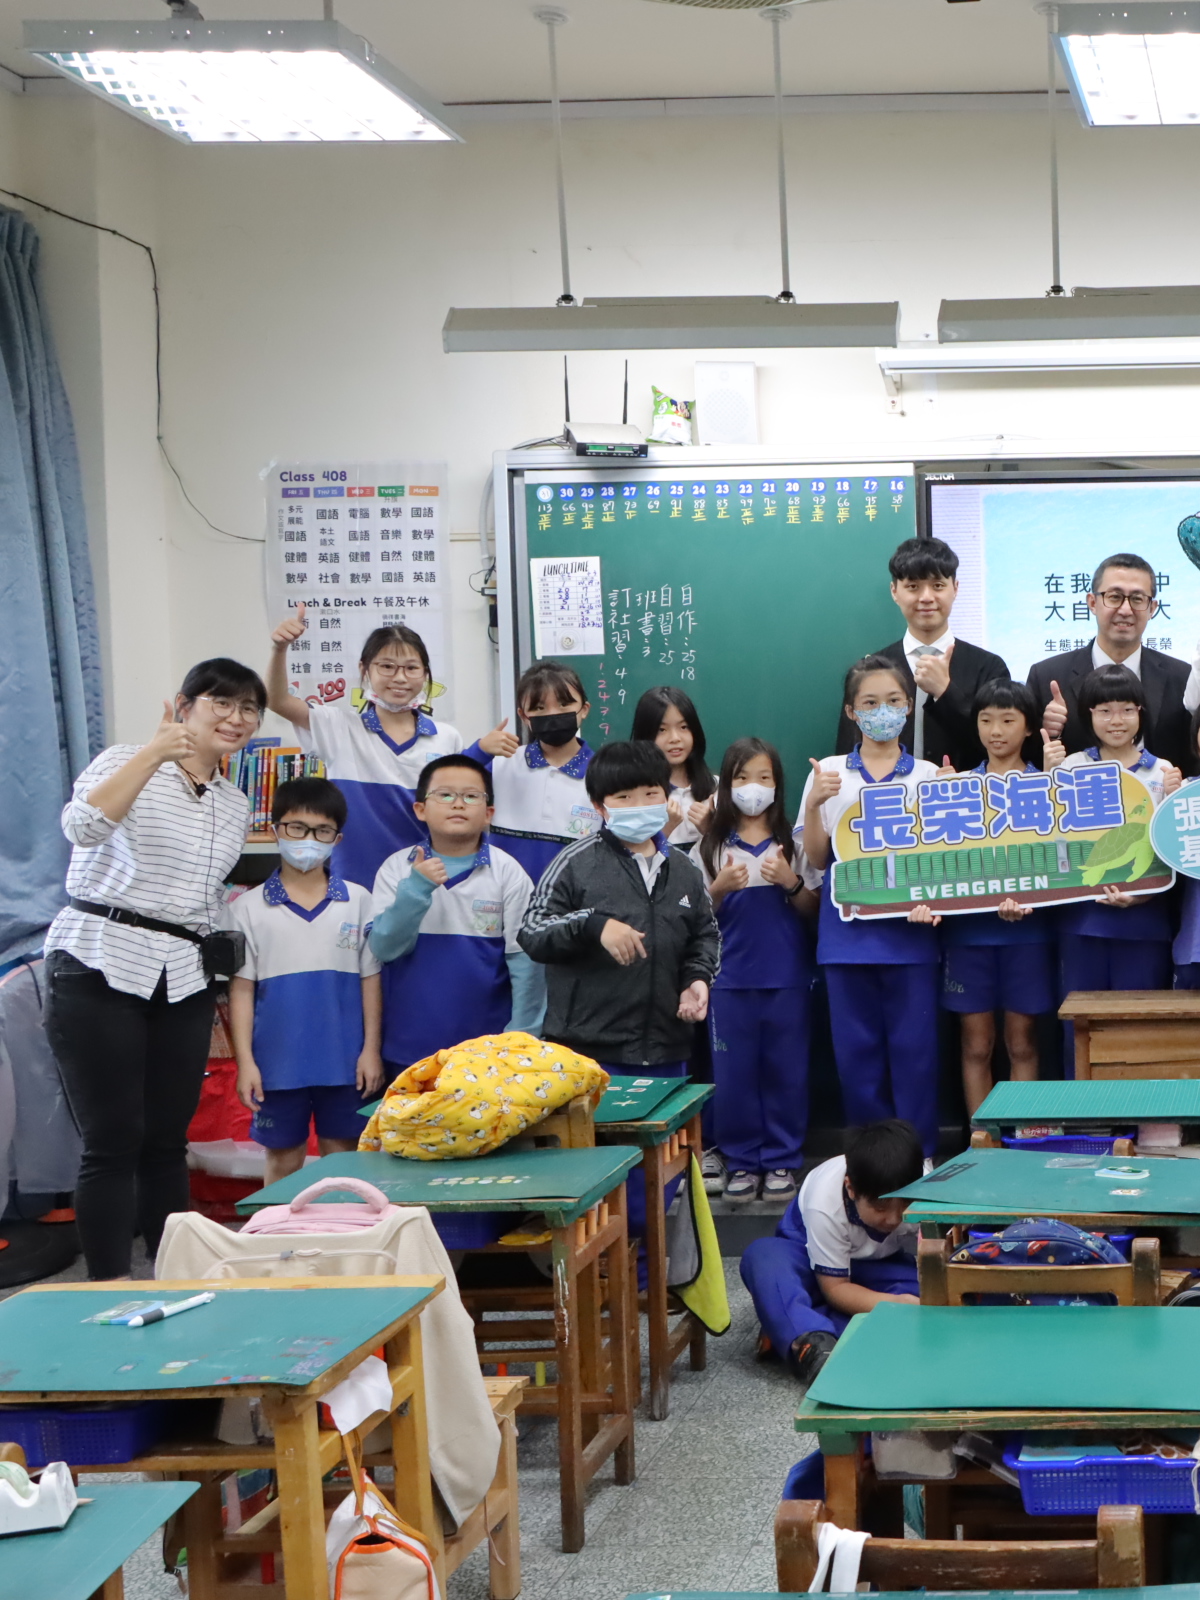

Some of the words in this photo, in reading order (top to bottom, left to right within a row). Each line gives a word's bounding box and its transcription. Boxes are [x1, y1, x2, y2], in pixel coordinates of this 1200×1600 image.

[280, 470, 316, 482] Class
[322, 470, 348, 482] 408
[560, 488, 574, 498] 30
[580, 488, 594, 498] 29
[600, 486, 615, 496] 28
[622, 486, 637, 496] 27
[646, 486, 660, 496] 26
[670, 486, 684, 495] 25
[692, 485, 706, 494] 24
[716, 484, 730, 494] 23
[738, 484, 753, 494] 22
[762, 482, 776, 492] 21
[786, 482, 800, 492] 20
[812, 482, 825, 491] 19
[836, 482, 850, 491] 18
[864, 480, 878, 490] 17
[890, 480, 904, 490] 16
[538, 504, 552, 514] 113
[562, 502, 576, 512] 66
[581, 502, 594, 512] 90
[602, 501, 615, 511] 87
[648, 500, 660, 510] 69
[670, 499, 682, 509] 91
[693, 500, 706, 508] 88
[716, 498, 728, 508] 85
[740, 498, 753, 508] 99
[764, 498, 776, 508] 70
[788, 496, 800, 506] 68
[812, 496, 826, 505] 93
[836, 498, 850, 508] 66
[865, 496, 878, 506] 95
[892, 494, 903, 504] 58
[288, 506, 304, 514] 多元
[316, 508, 338, 520] 國語
[348, 508, 370, 519] 電腦
[380, 508, 402, 518] 數學
[411, 507, 434, 518] 國語
[284, 530, 306, 542] 國語
[320, 527, 334, 535] 本土
[348, 530, 370, 541] 國語
[380, 529, 402, 540] 音樂
[412, 529, 434, 540] 數學
[320, 538, 334, 546] 語文
[284, 552, 308, 563] 健體
[318, 552, 340, 564] 英語
[348, 551, 370, 562] 健體
[381, 550, 402, 562] 自然
[412, 550, 435, 562] 健體
[543, 564, 568, 576] LUNCH
[571, 561, 588, 574] TIME
[286, 572, 308, 584] 數學
[318, 572, 340, 584] 社會
[350, 572, 372, 584] 數學
[382, 572, 404, 582] 國語
[412, 572, 436, 582] 英語
[323, 598, 331, 608] &
[334, 598, 367, 607] Break
[372, 596, 430, 608] 午餐及午休
[320, 618, 342, 629] 自然
[290, 640, 311, 651] 藝術
[320, 641, 342, 652] 自然
[291, 662, 312, 674] 社會
[322, 662, 344, 674] 綜合
[318, 678, 346, 698] 100
[850, 764, 1126, 852] 長榮海運
[910, 874, 1050, 902] EVERGREEN
